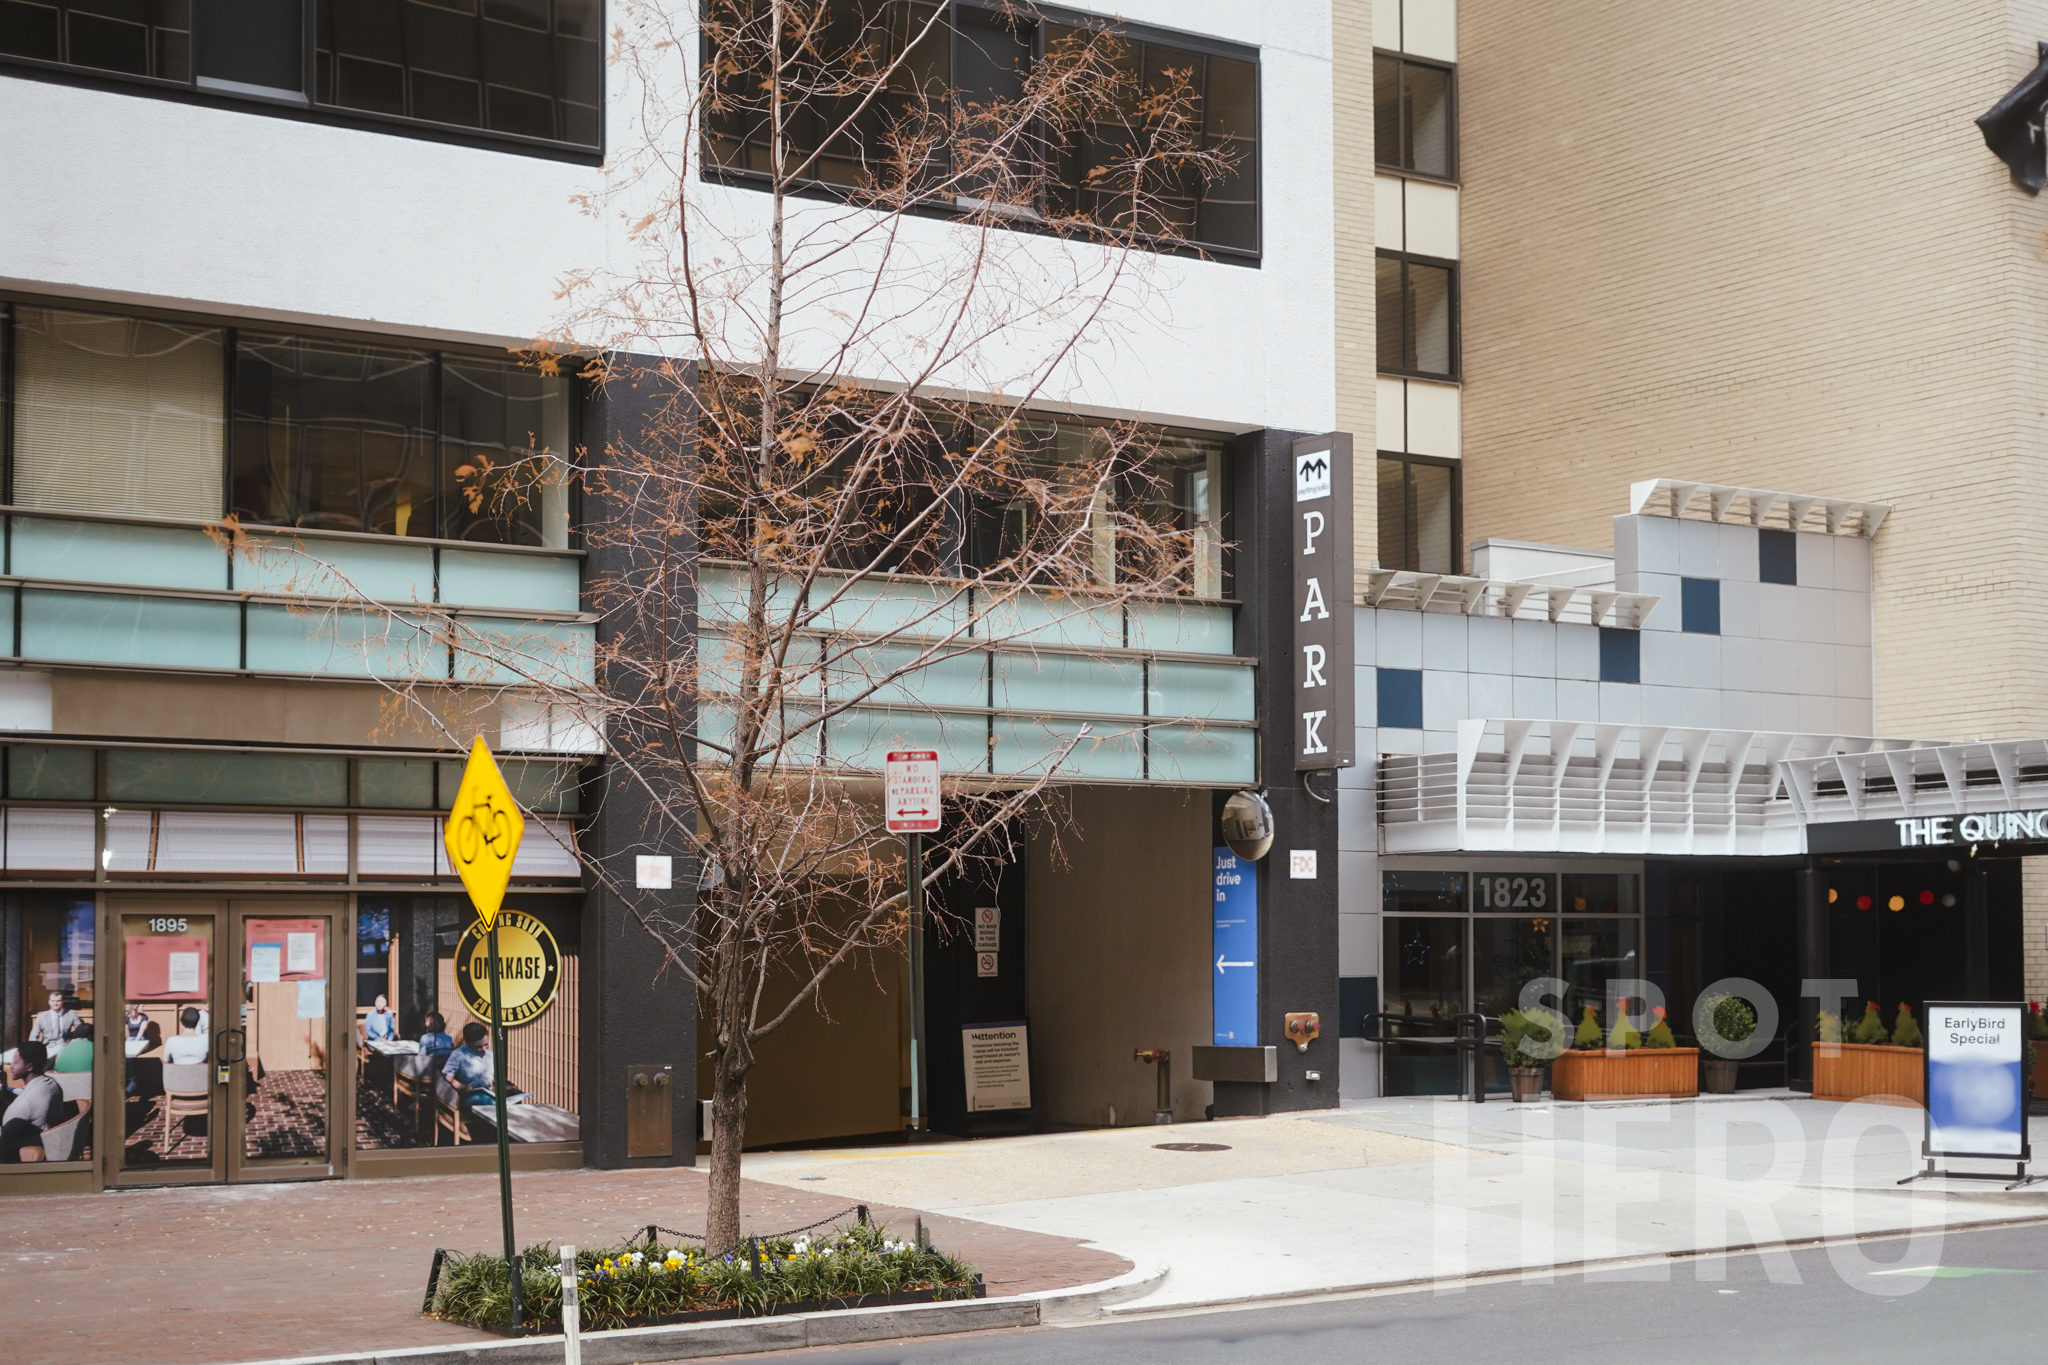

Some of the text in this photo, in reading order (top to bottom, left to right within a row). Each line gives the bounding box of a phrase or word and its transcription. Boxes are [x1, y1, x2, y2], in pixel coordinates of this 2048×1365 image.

[1300, 510, 1330, 755] PARK
[906, 764, 919, 773] NO
[893, 775, 932, 784] STANDING
[900, 786, 934, 795] PARKING
[897, 797, 931, 806] ANYTIME
[1895, 817, 1952, 846] THE
[1216, 856, 1237, 870] Just
[1216, 872, 1241, 886] drive
[1216, 888, 1226, 902] in
[1479, 877, 1547, 908] 1823
[148, 917, 188, 933] 1895
[471, 913, 545, 940] CONG SOON
[472, 995, 545, 1023] CONG SOON
[1950, 1033, 2000, 1046] Special
